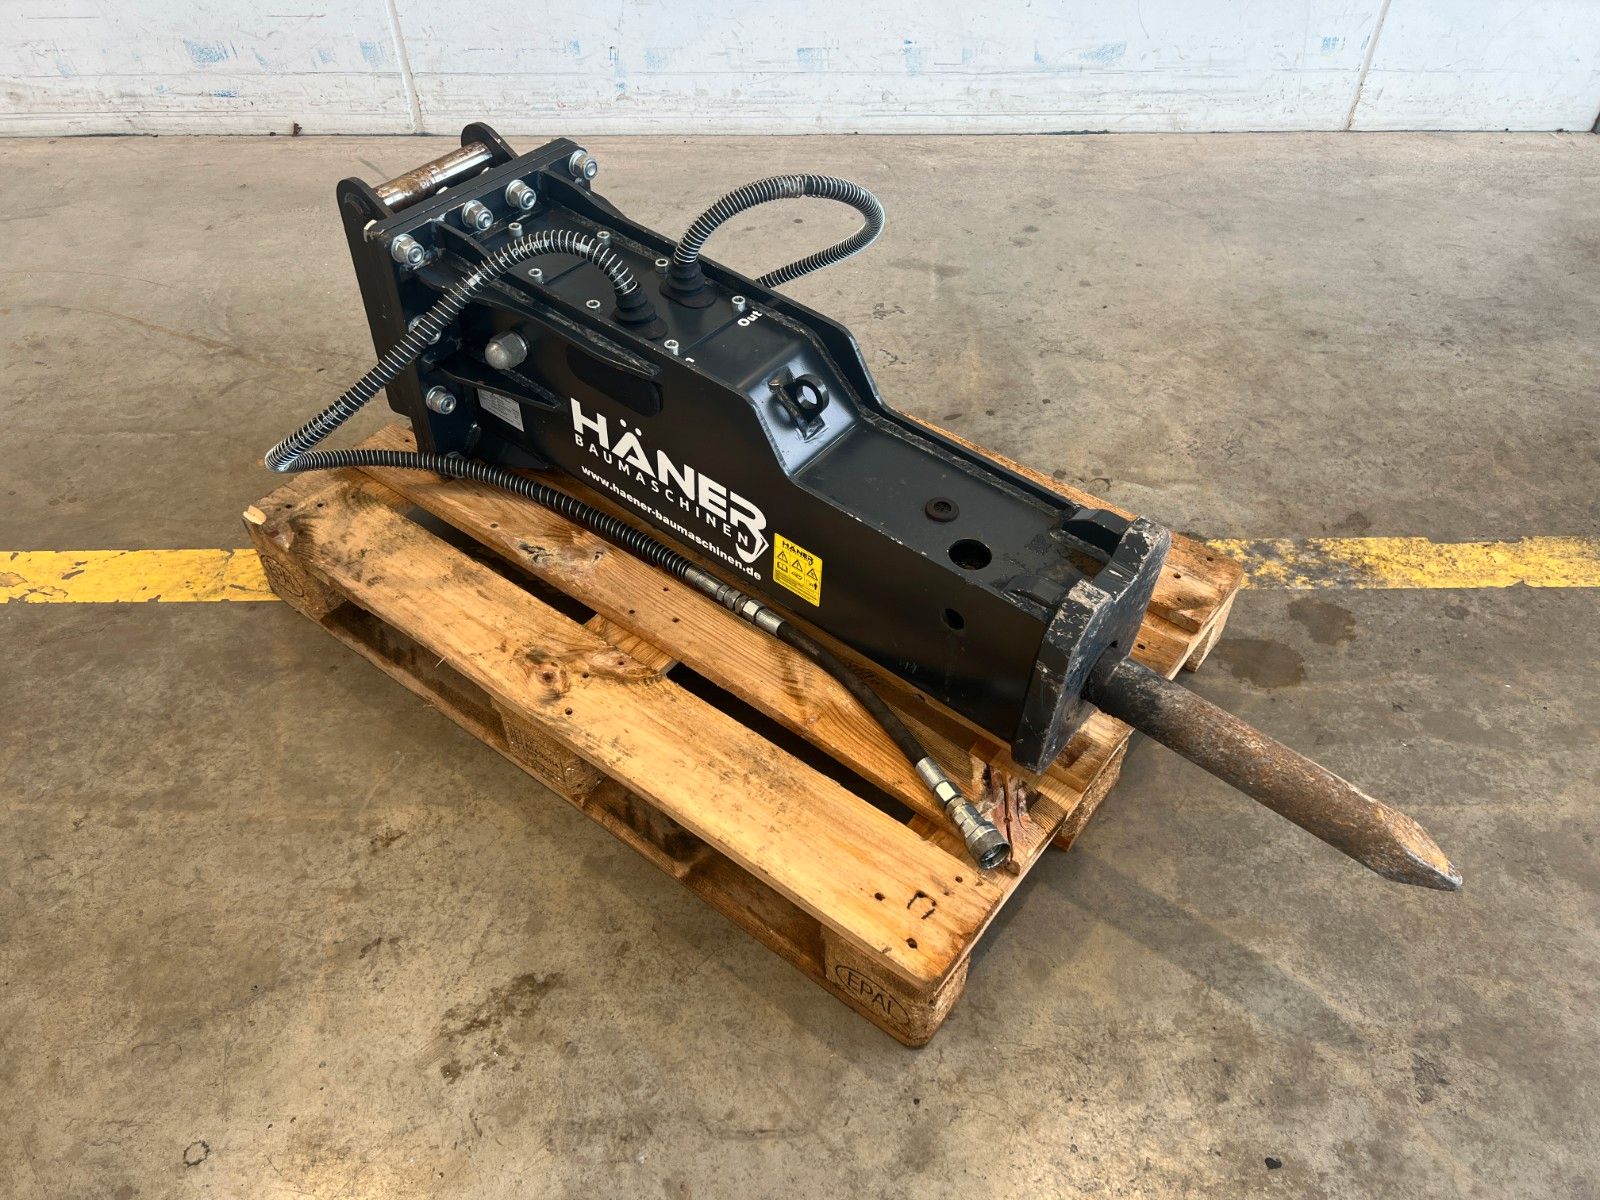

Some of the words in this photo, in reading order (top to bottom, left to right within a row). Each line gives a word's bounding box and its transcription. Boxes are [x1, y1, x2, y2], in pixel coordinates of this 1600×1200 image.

[738, 310, 762, 327] Out
[570, 397, 769, 564] HÄNER
[575, 433, 750, 547] BAUMASCHINEN
[581, 465, 762, 581] www.haener-baumaschinen.de
